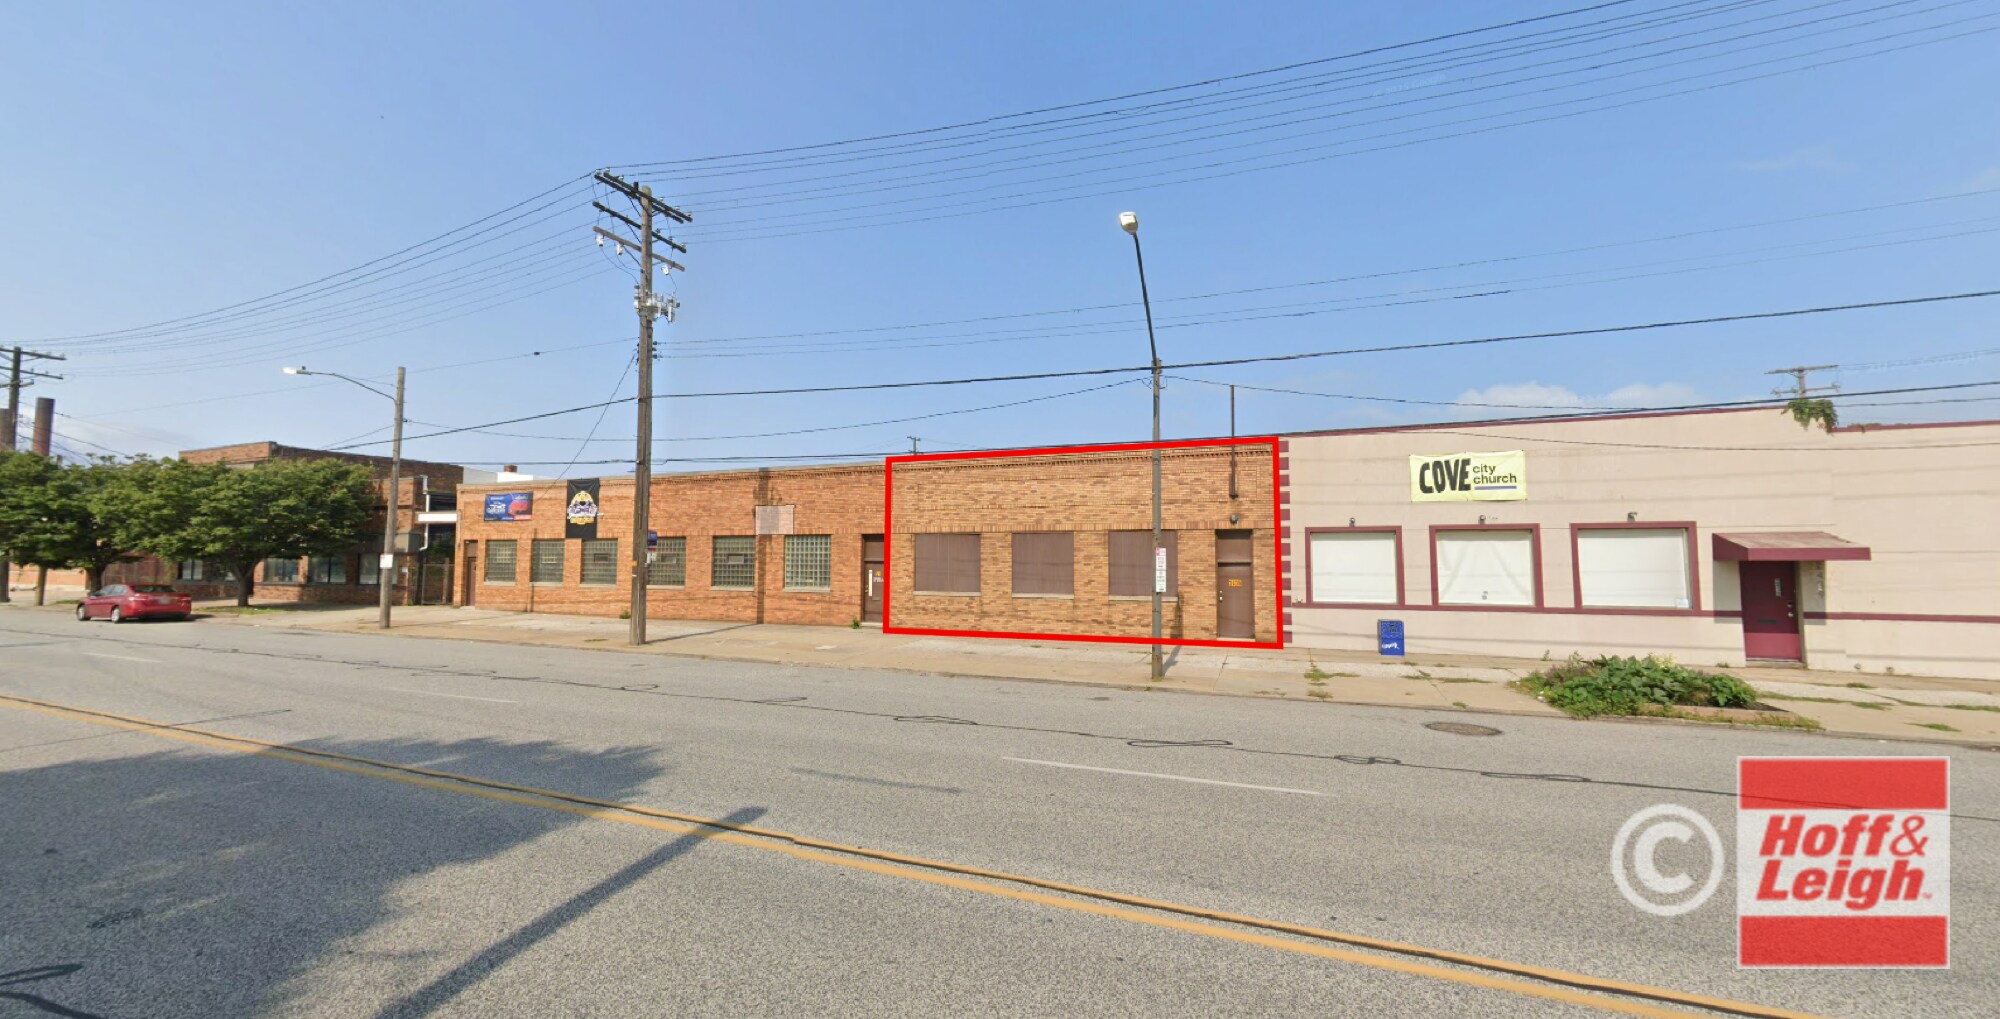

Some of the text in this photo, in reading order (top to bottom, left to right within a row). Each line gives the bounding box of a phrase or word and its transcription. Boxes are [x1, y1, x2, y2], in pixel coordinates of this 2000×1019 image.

[1473, 464, 1496, 474] city
[1419, 458, 1471, 493] COVE
[1473, 473, 1517, 484] church
